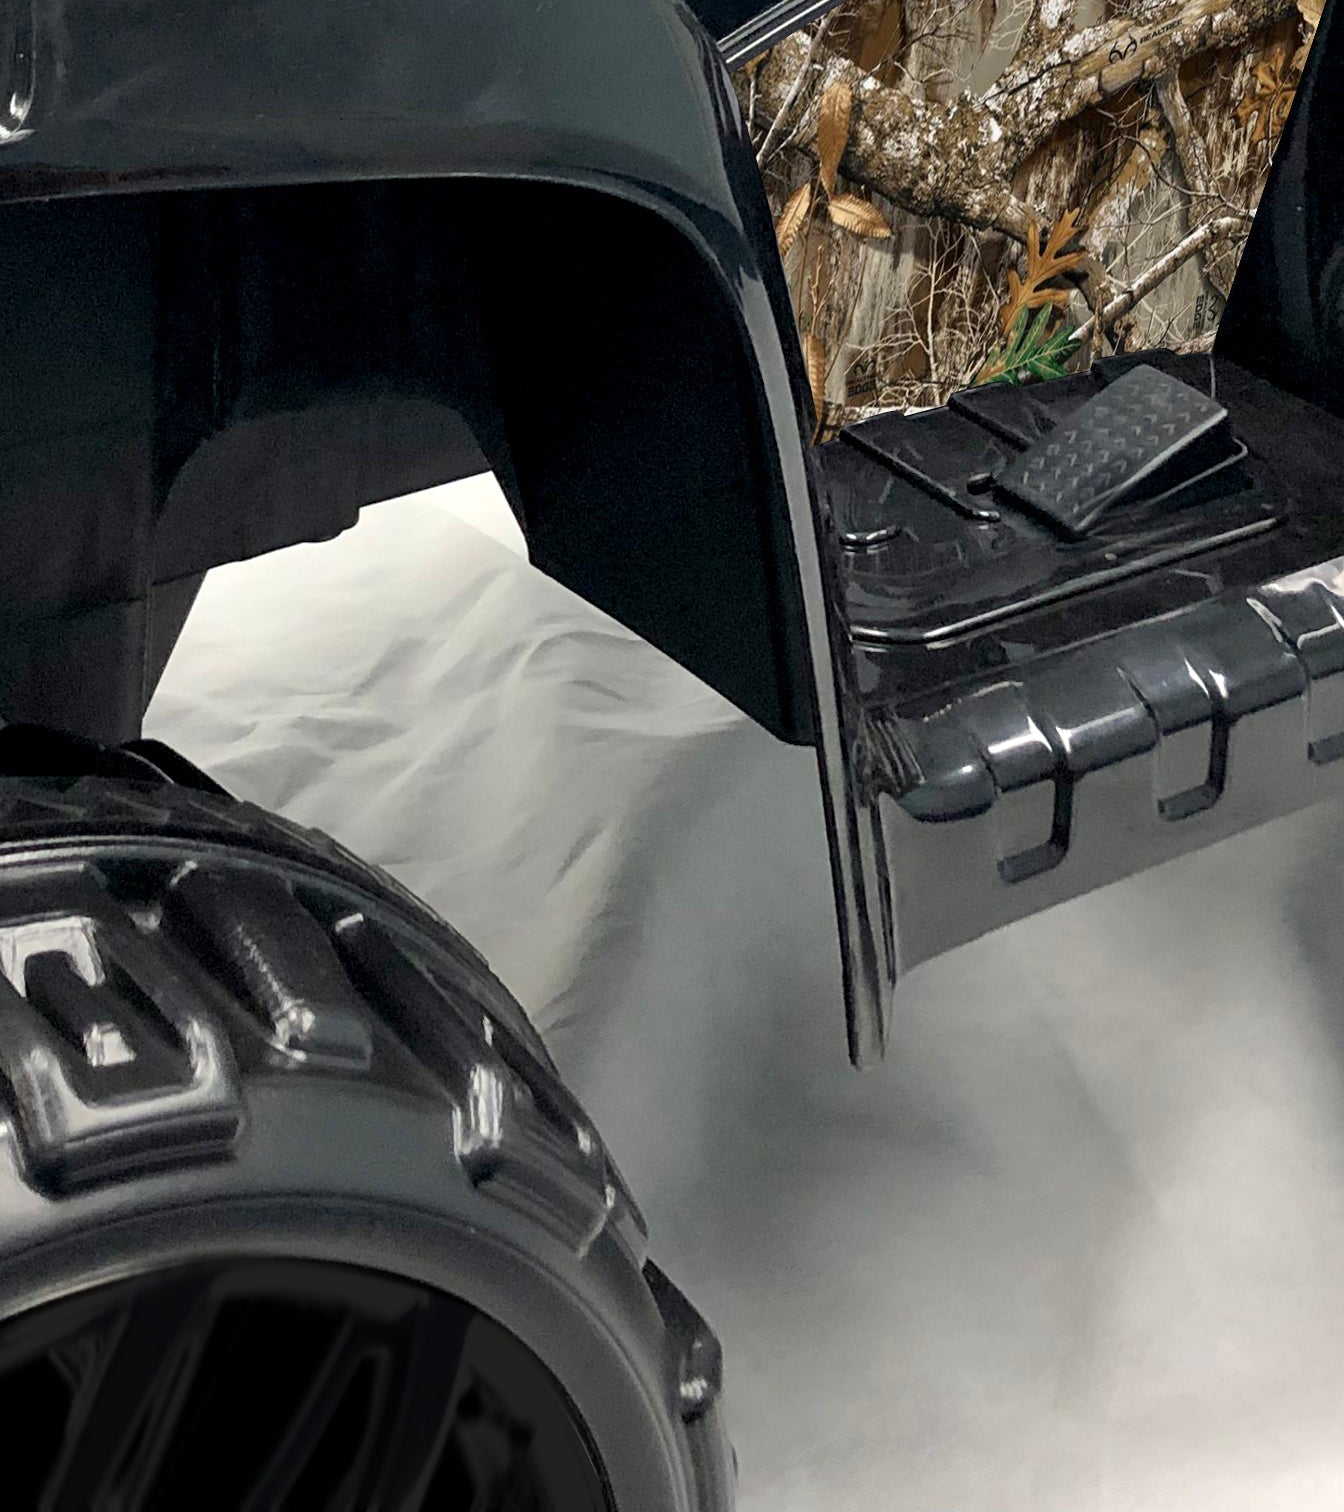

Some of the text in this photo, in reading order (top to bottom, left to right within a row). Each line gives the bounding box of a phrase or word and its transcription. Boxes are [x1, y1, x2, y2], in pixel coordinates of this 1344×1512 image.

[1139, 18, 1183, 44] REALTREE
[1193, 294, 1204, 330] EDGE
[847, 380, 876, 397] EDGE
